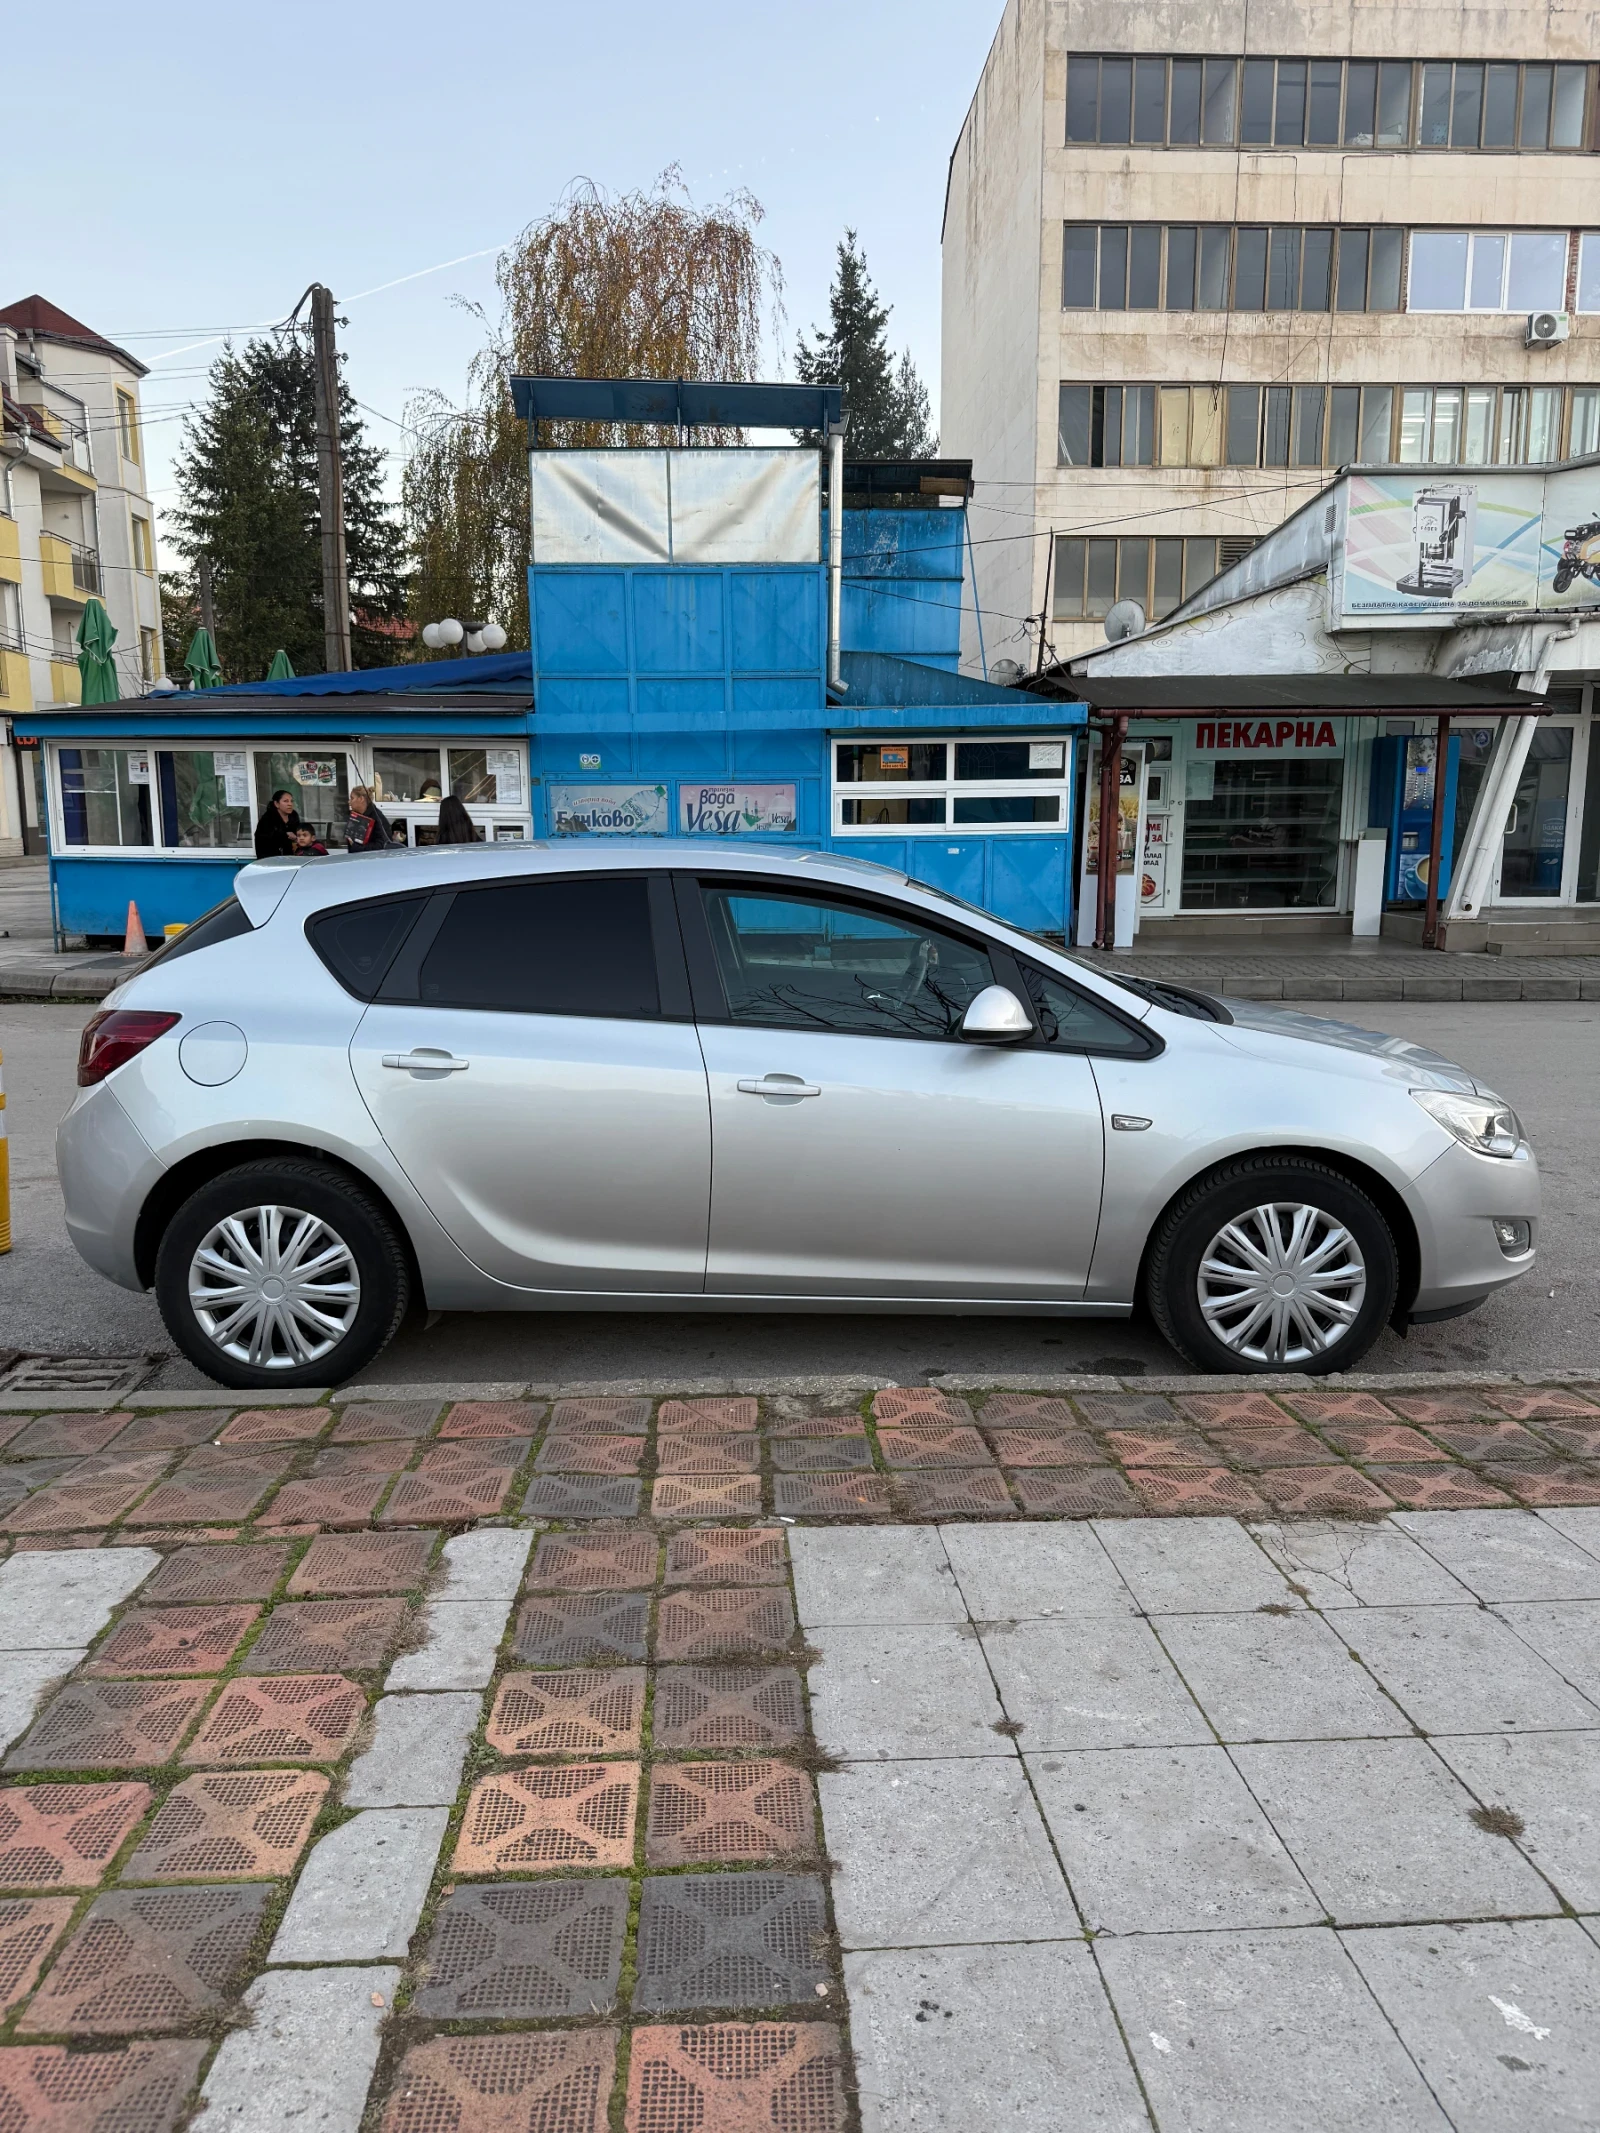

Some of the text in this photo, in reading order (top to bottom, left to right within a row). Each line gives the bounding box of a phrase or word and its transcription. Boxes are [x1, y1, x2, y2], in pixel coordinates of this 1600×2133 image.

[1351, 601, 1397, 609] БЕЗПЛАТНА
[1457, 600, 1467, 608] ЗА
[1468, 600, 1491, 608] ДОМА
[1500, 599, 1528, 607] ОФИСА
[1196, 721, 1337, 748] ПЕКАРНА
[686, 801, 741, 832] Vesa
[1151, 834, 1163, 843] ЗА
